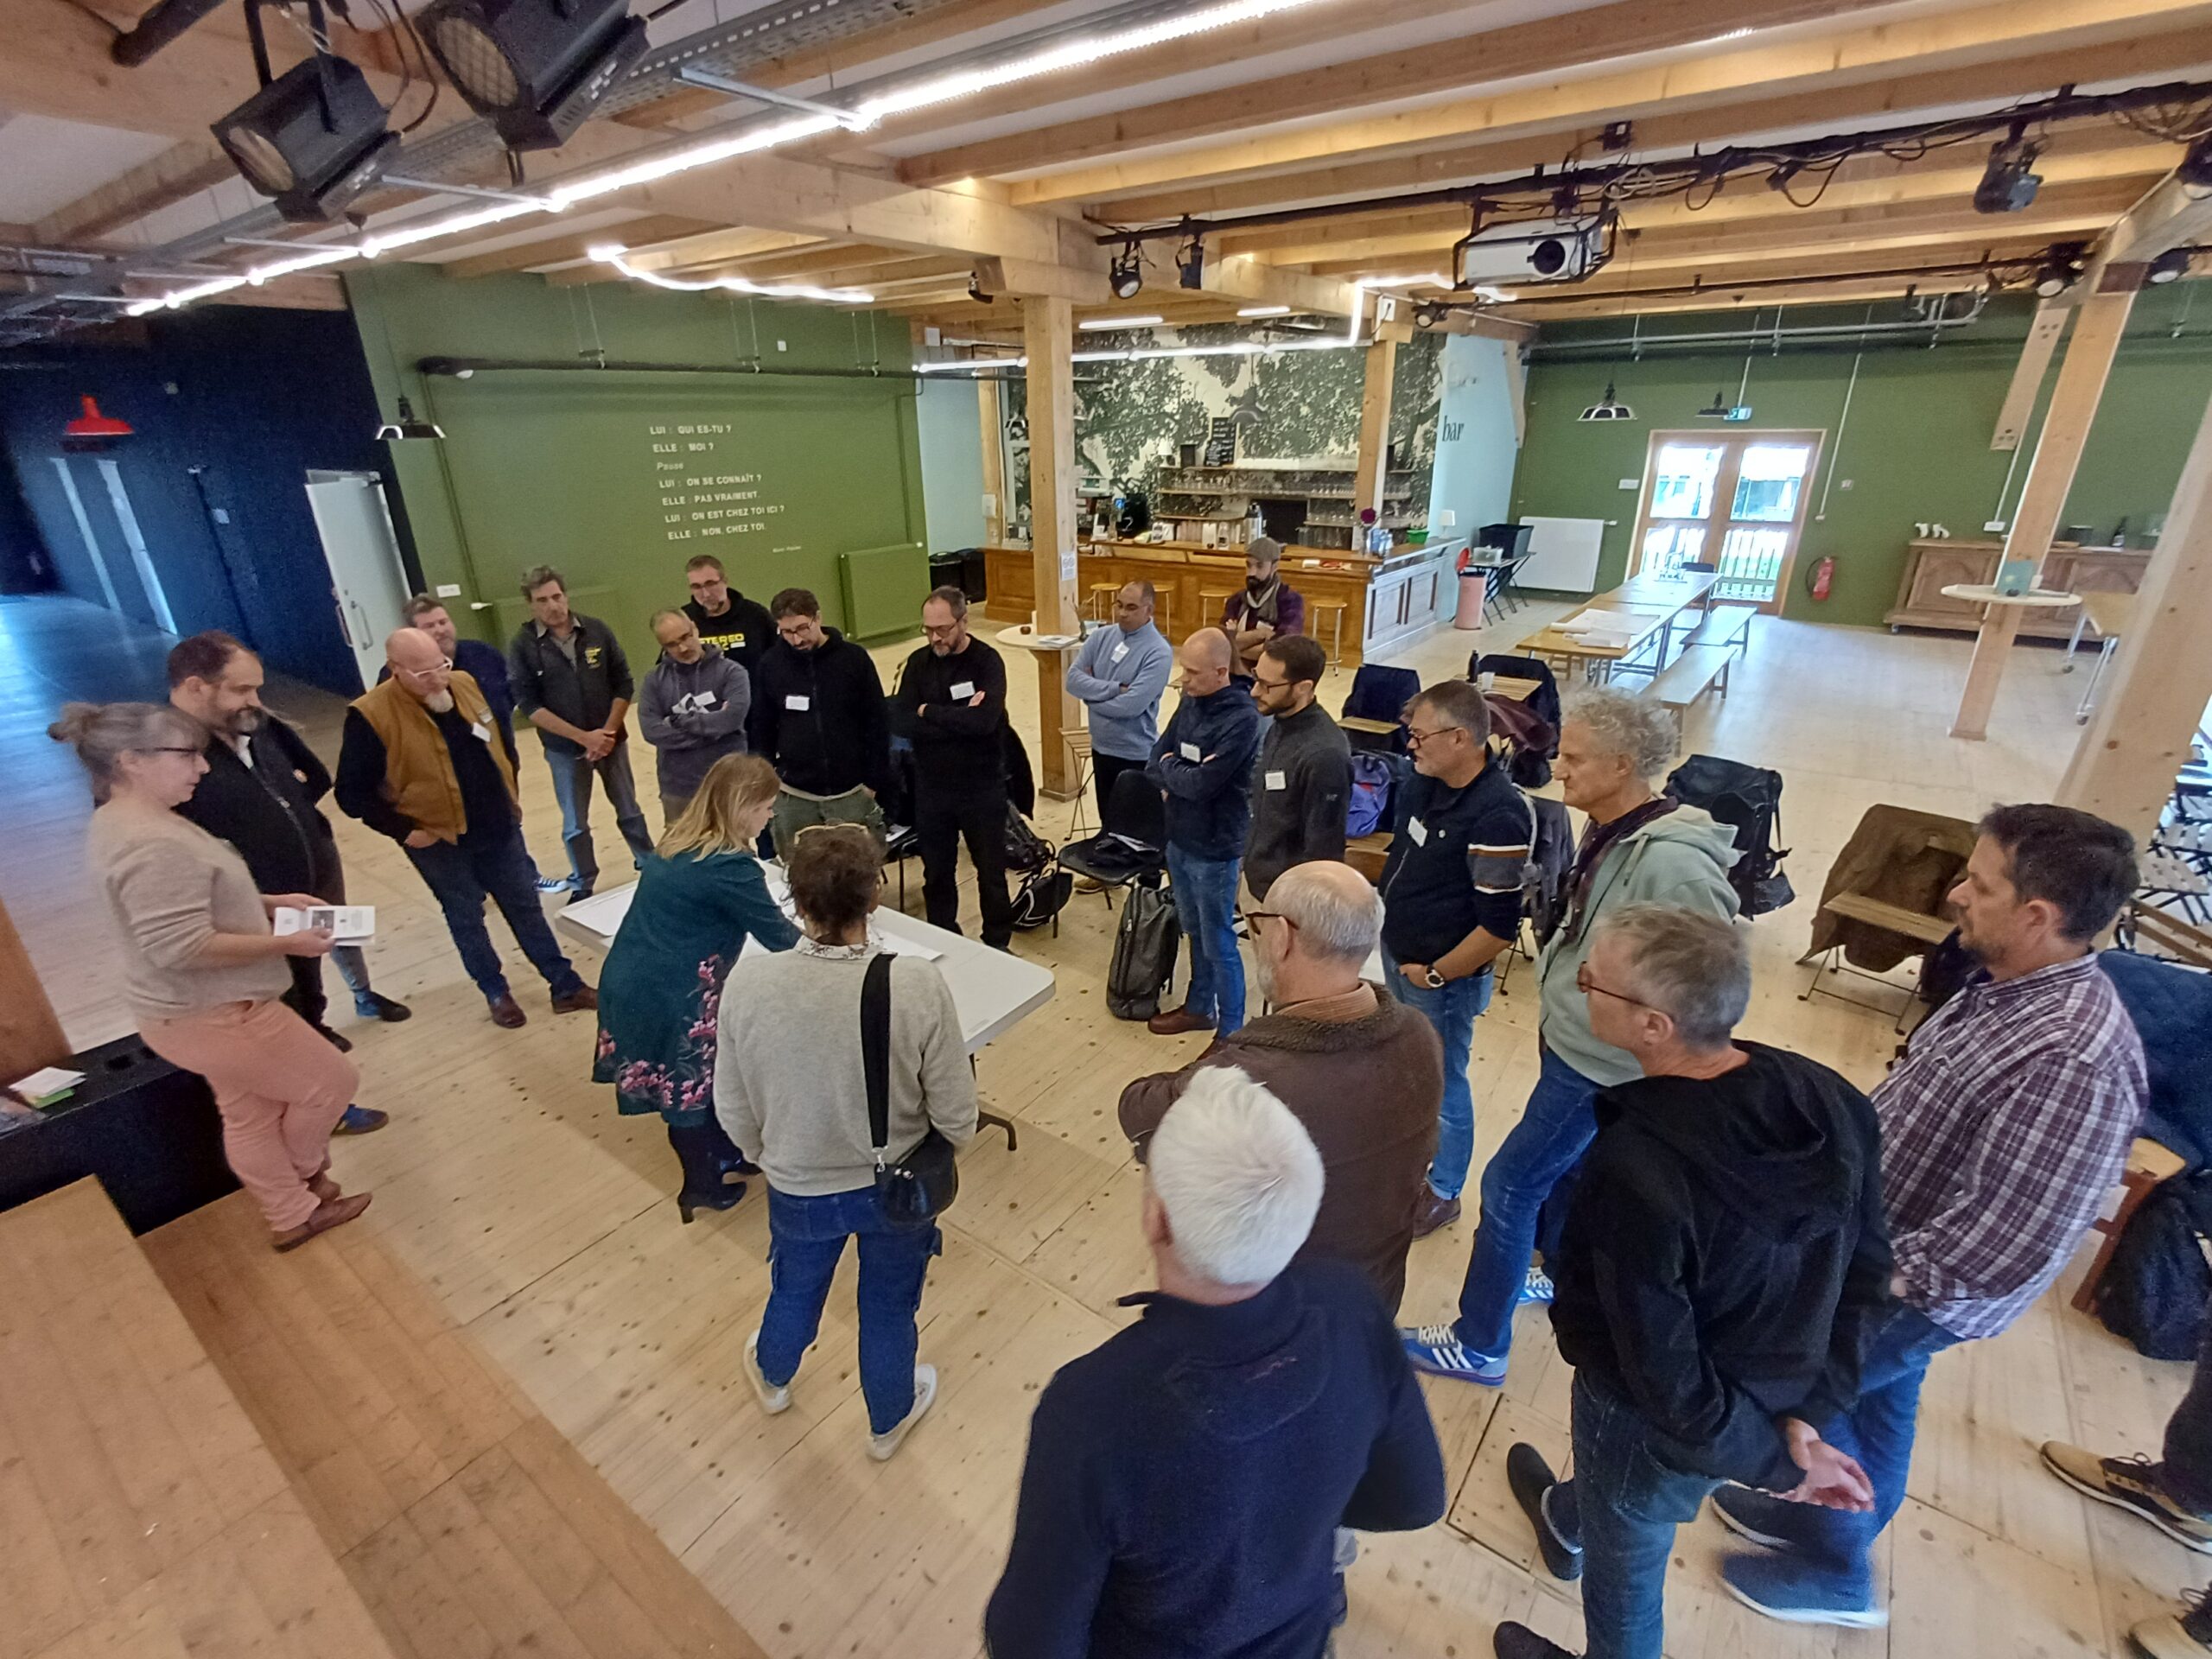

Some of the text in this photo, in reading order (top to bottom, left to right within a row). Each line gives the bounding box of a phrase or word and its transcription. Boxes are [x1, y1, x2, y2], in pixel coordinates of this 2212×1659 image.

[650, 426, 666, 435] LUI
[677, 425, 695, 435] QUI
[696, 424, 724, 434] ES-TU
[1442, 415, 1465, 442] bar
[652, 443, 677, 453] ELLE
[688, 442, 706, 451] MOI
[657, 461, 684, 471] Pause
[659, 479, 675, 488] LUI
[686, 478, 700, 486] ON
[702, 477, 715, 486] SE
[662, 496, 686, 506] ELLE
[694, 493, 713, 503] PAS
[664, 514, 681, 523] LUI
[691, 512, 705, 521] ON
[707, 510, 724, 519] EST
[726, 508, 749, 518] CHEZ
[750, 506, 766, 515] TOI
[667, 530, 691, 540] ELLE
[726, 524, 749, 534] CHEZ
